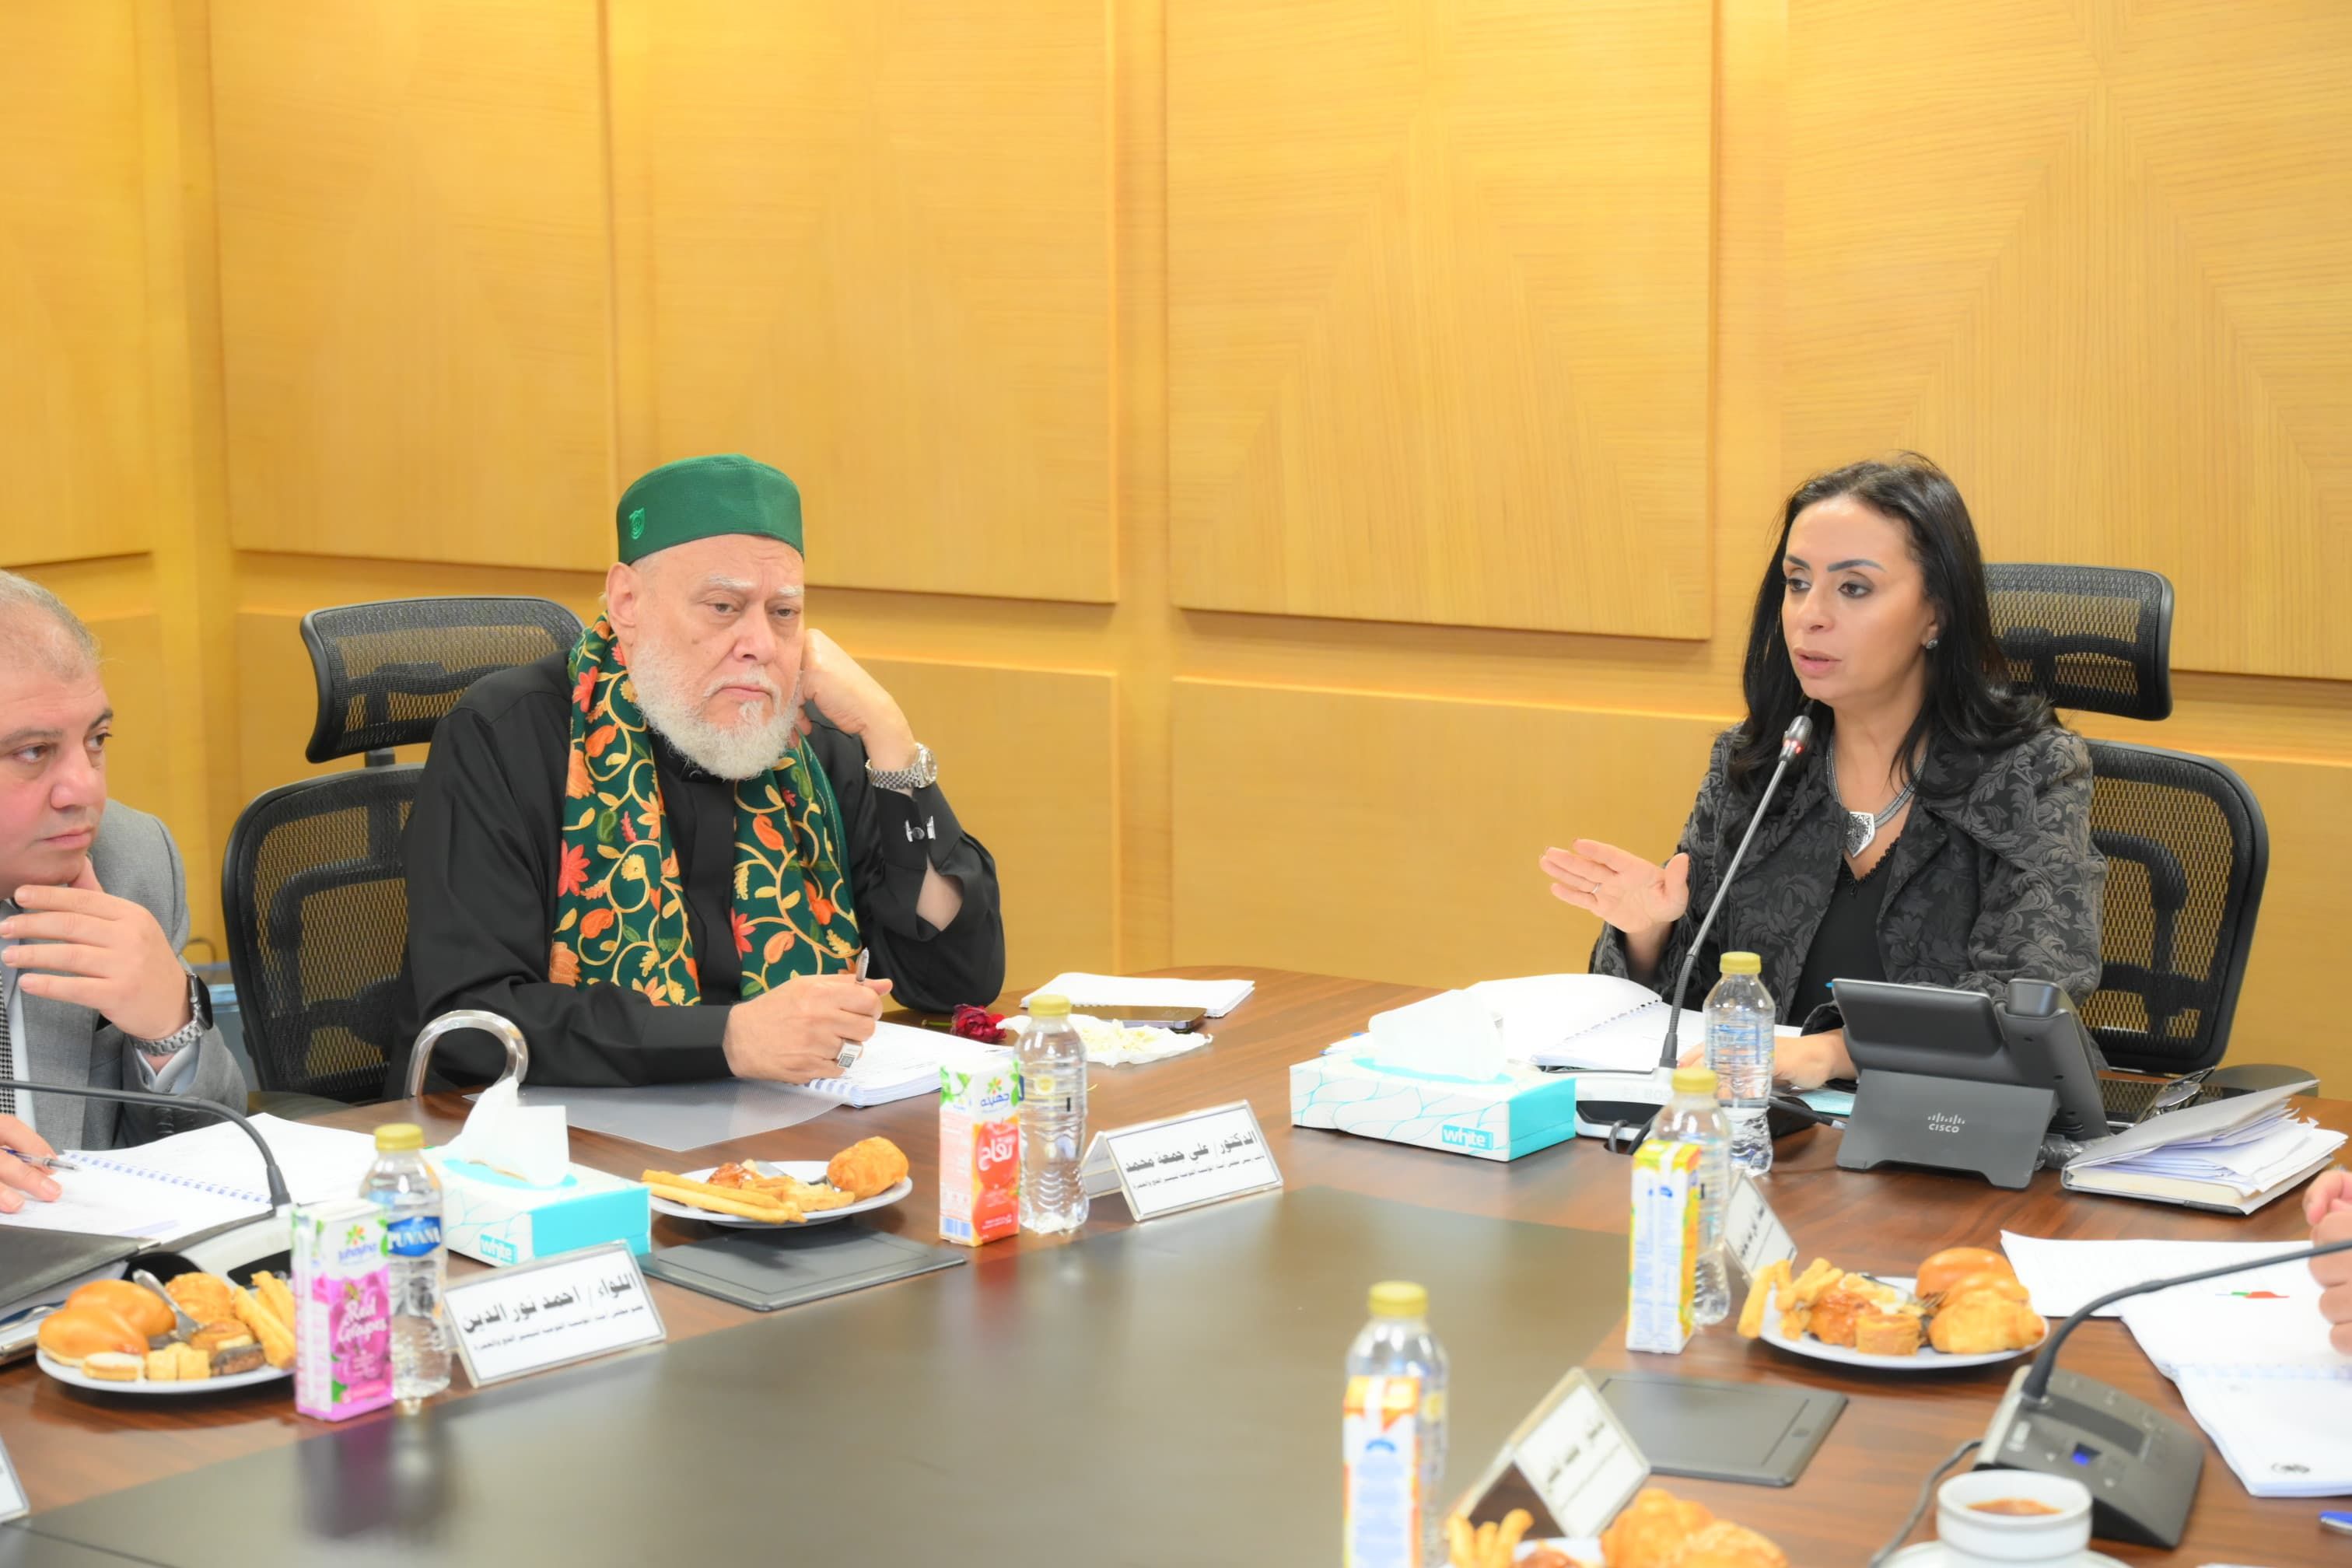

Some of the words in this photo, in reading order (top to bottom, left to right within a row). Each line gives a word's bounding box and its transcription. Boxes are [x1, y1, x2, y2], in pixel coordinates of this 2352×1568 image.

[1444, 1127, 1486, 1147] white
[1125, 1157, 1154, 1172] محمد
[598, 1272, 638, 1298] اللواء
[464, 1303, 508, 1334] الدين
